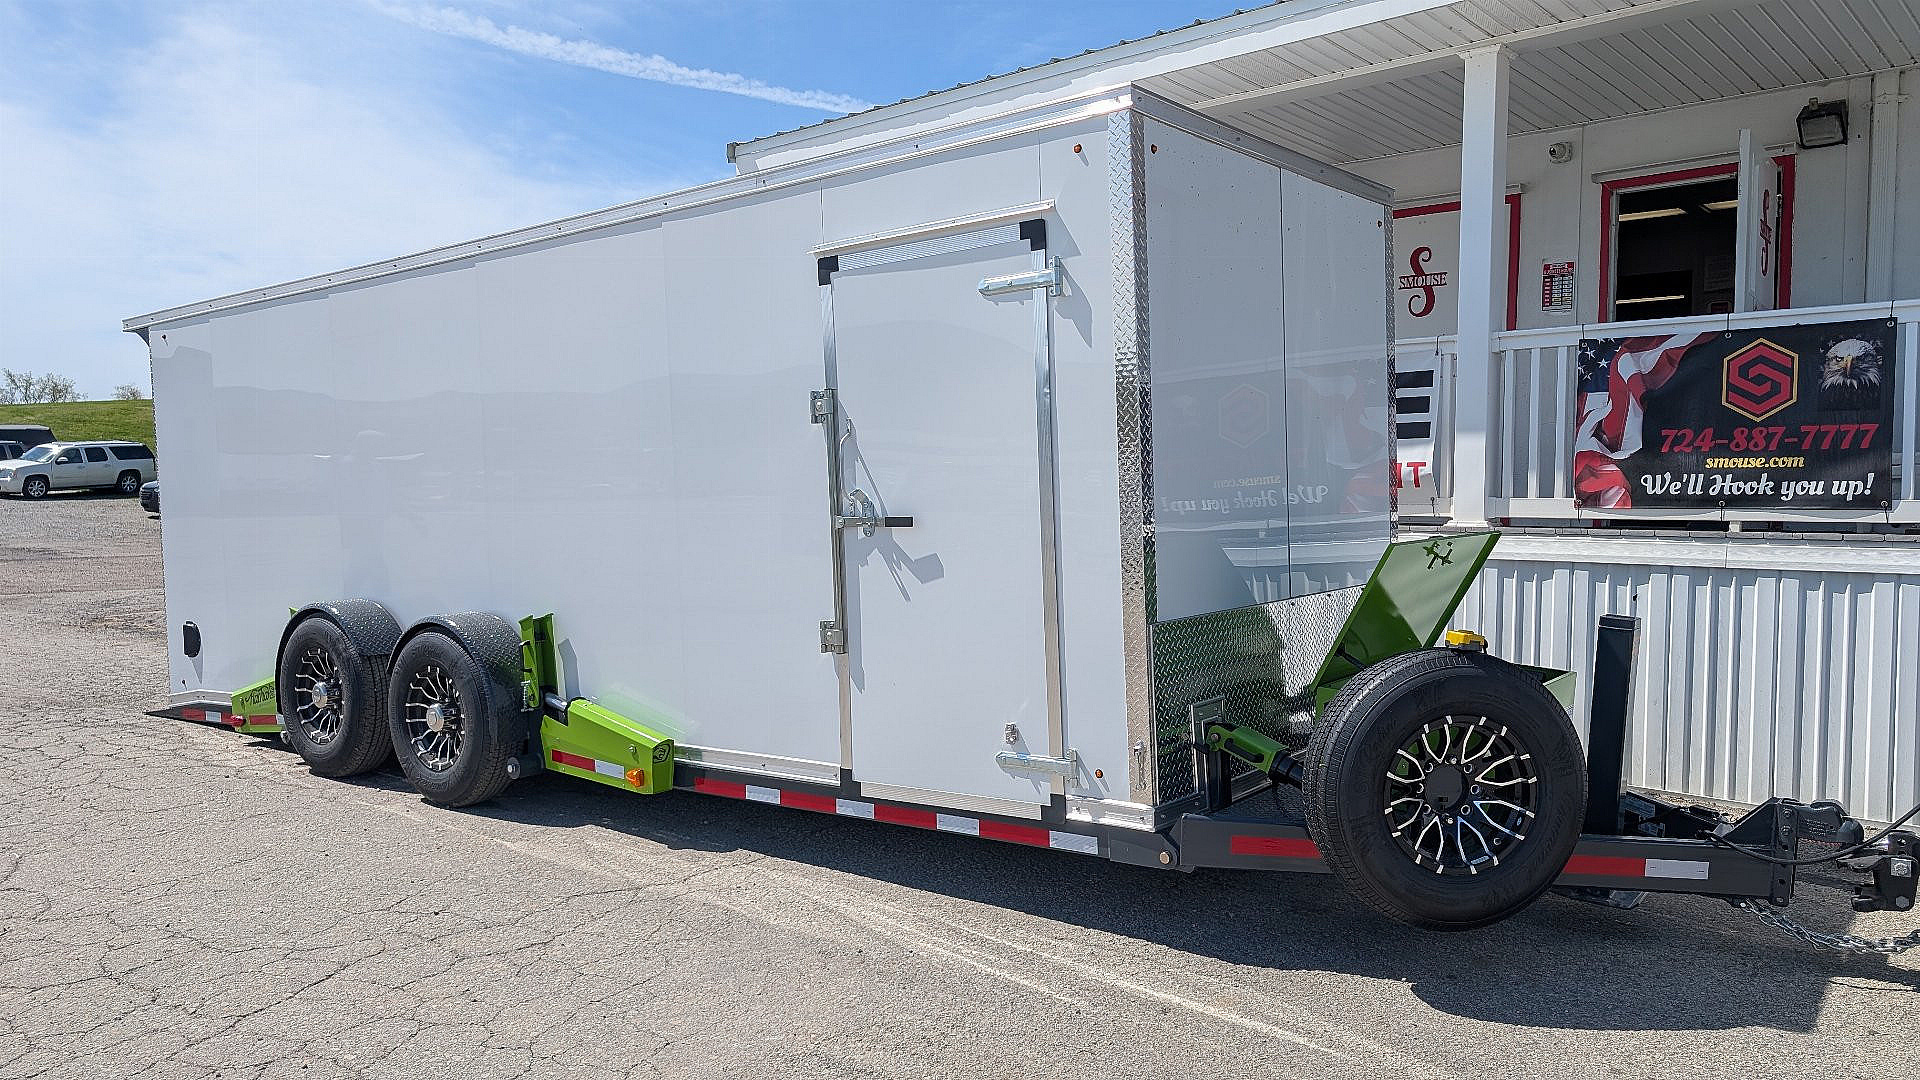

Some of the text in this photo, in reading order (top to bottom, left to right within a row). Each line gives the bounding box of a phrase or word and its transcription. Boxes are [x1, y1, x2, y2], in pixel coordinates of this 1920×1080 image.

[1399, 273, 1448, 288] SMOUSE
[1660, 423, 1880, 453] 724-887-7777
[1705, 455, 1805, 469] smouse.com
[1640, 471, 1875, 502] We'll Hook you up!
